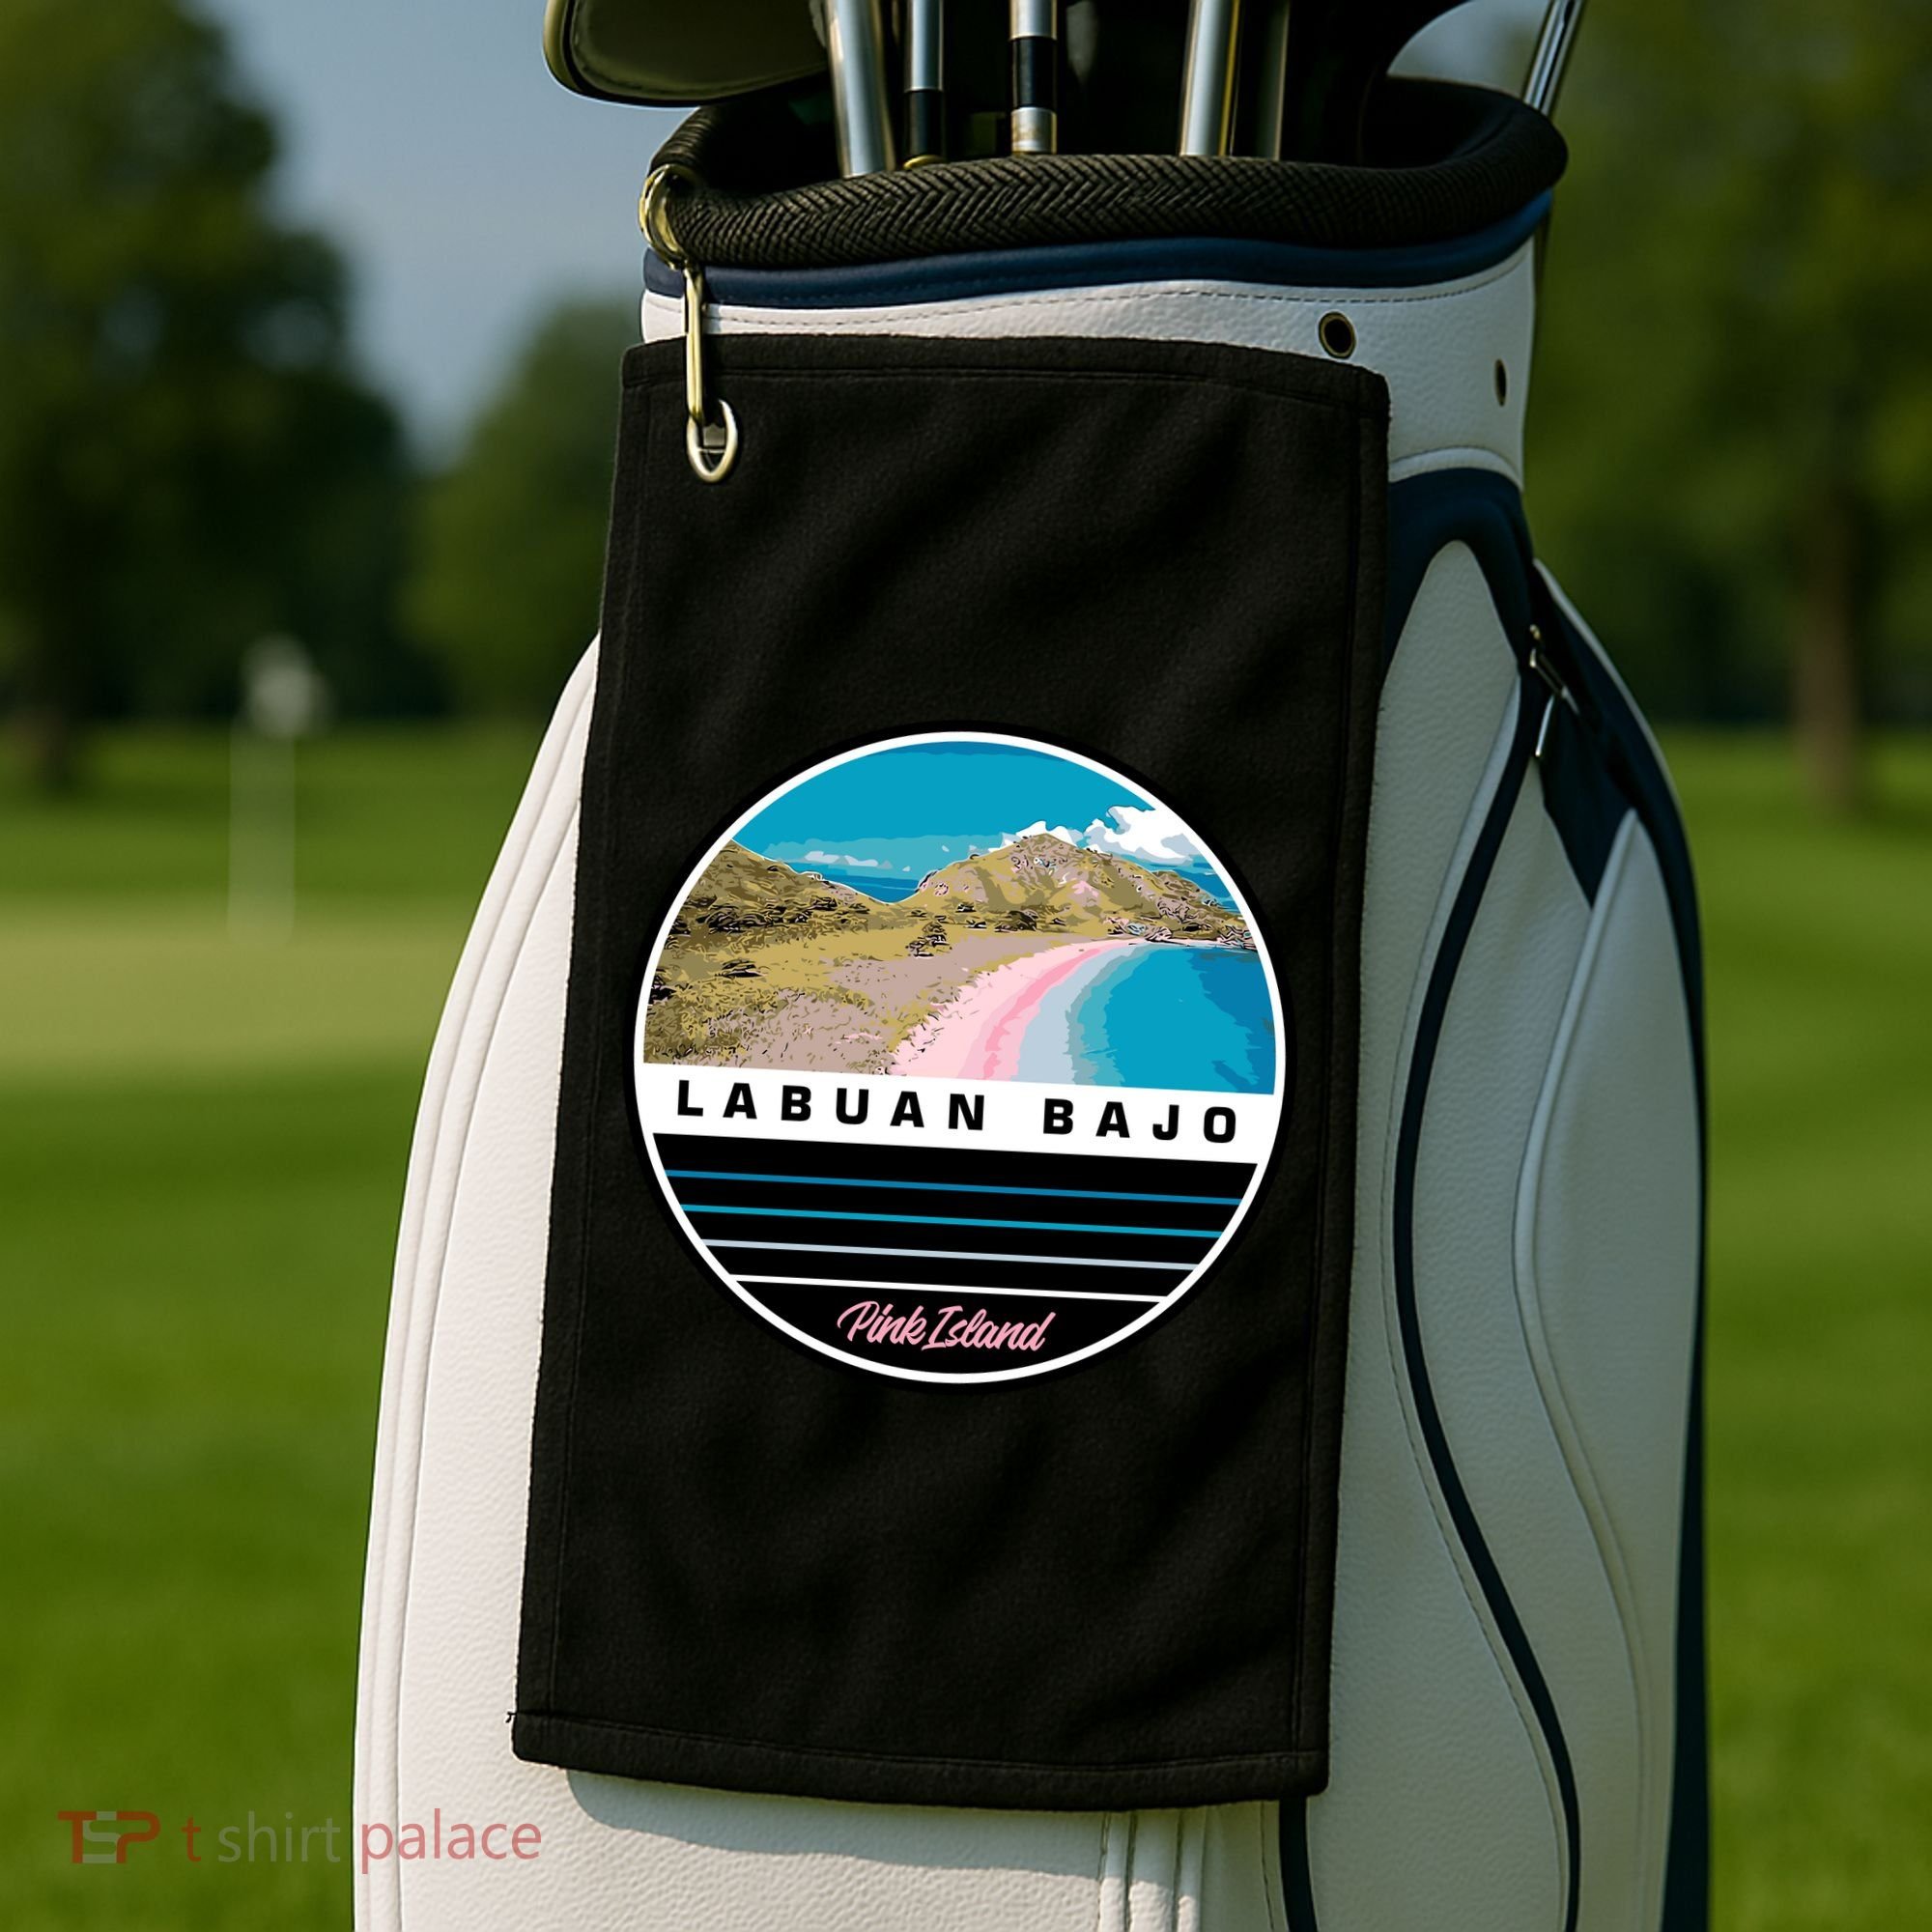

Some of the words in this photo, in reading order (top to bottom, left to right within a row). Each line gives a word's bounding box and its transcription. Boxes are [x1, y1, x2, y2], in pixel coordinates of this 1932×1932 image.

[676, 1079, 985, 1131] LABUAN
[1042, 1097, 1237, 1144] BAJO
[837, 1300, 926, 1346] Pink
[921, 1305, 1057, 1351] Island
